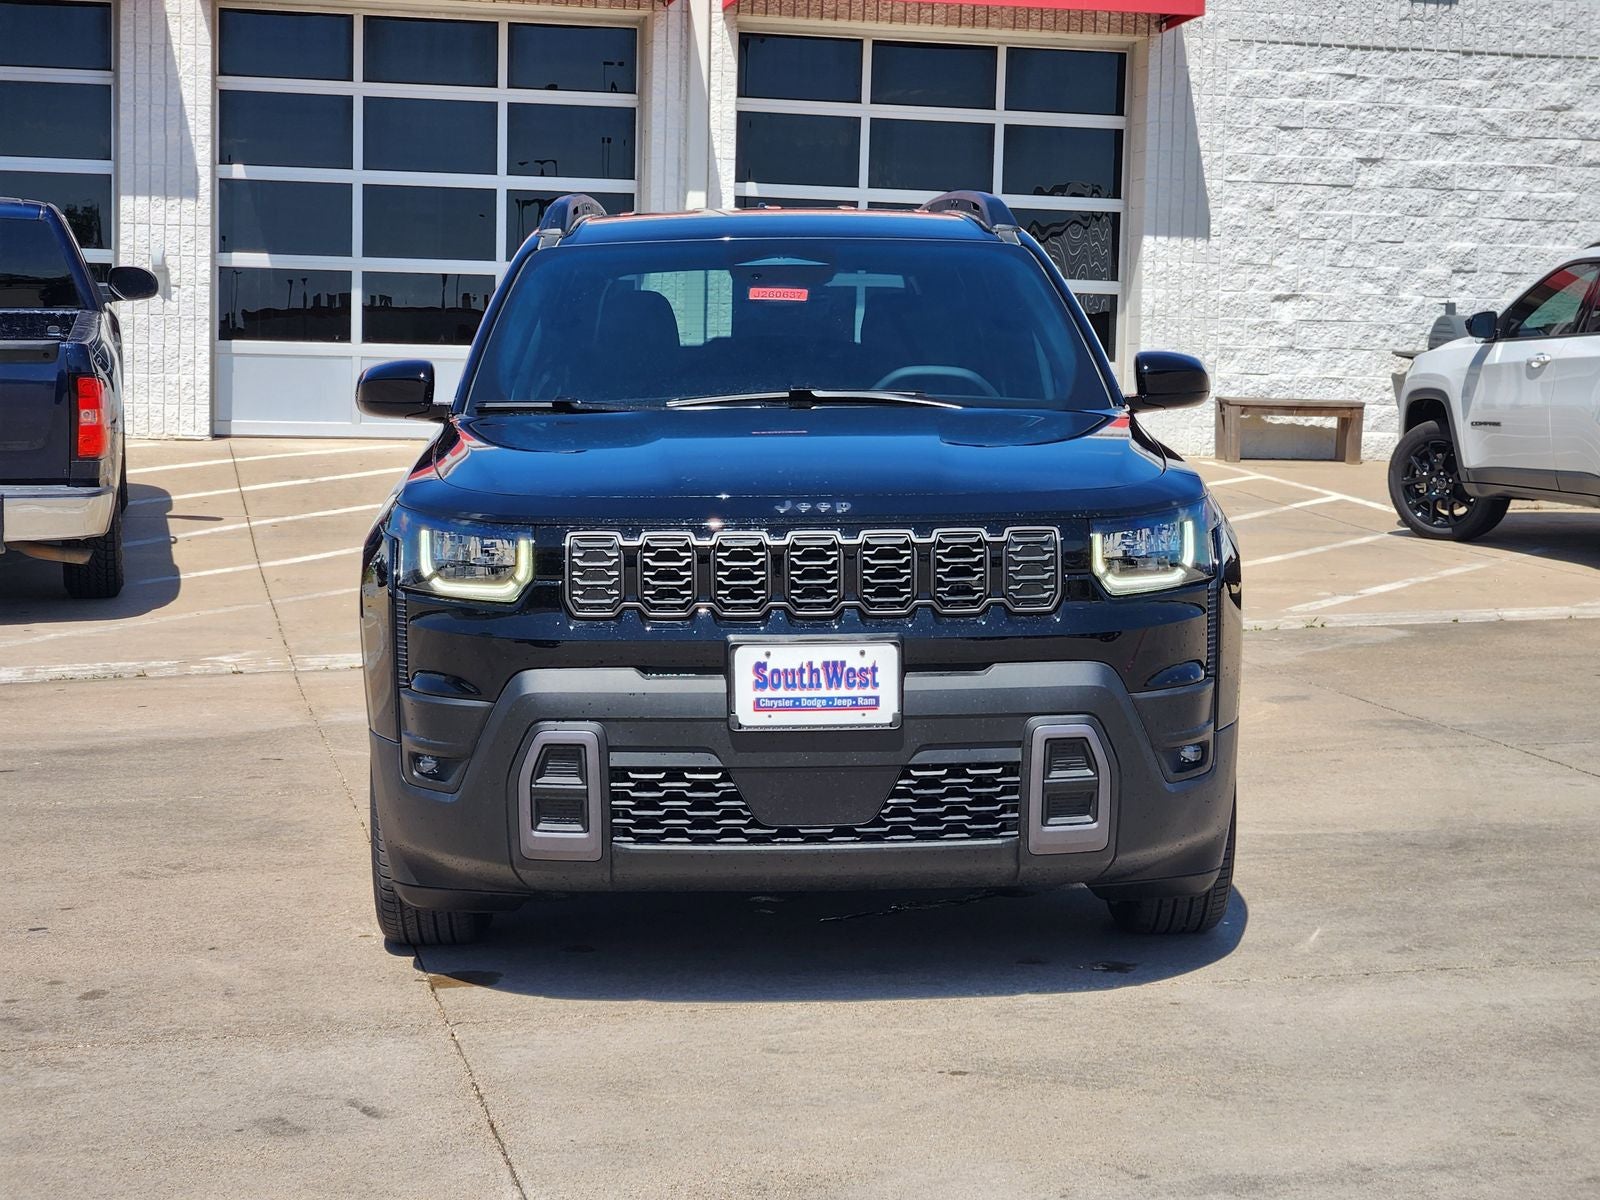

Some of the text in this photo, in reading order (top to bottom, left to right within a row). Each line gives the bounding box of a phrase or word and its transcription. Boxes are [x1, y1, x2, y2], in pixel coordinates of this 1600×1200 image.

[753, 291, 803, 299] J260637
[774, 500, 852, 514] Jeep
[752, 660, 879, 691] SouthWest
[759, 697, 876, 708] Chrysler Dodge Jeep Ram
